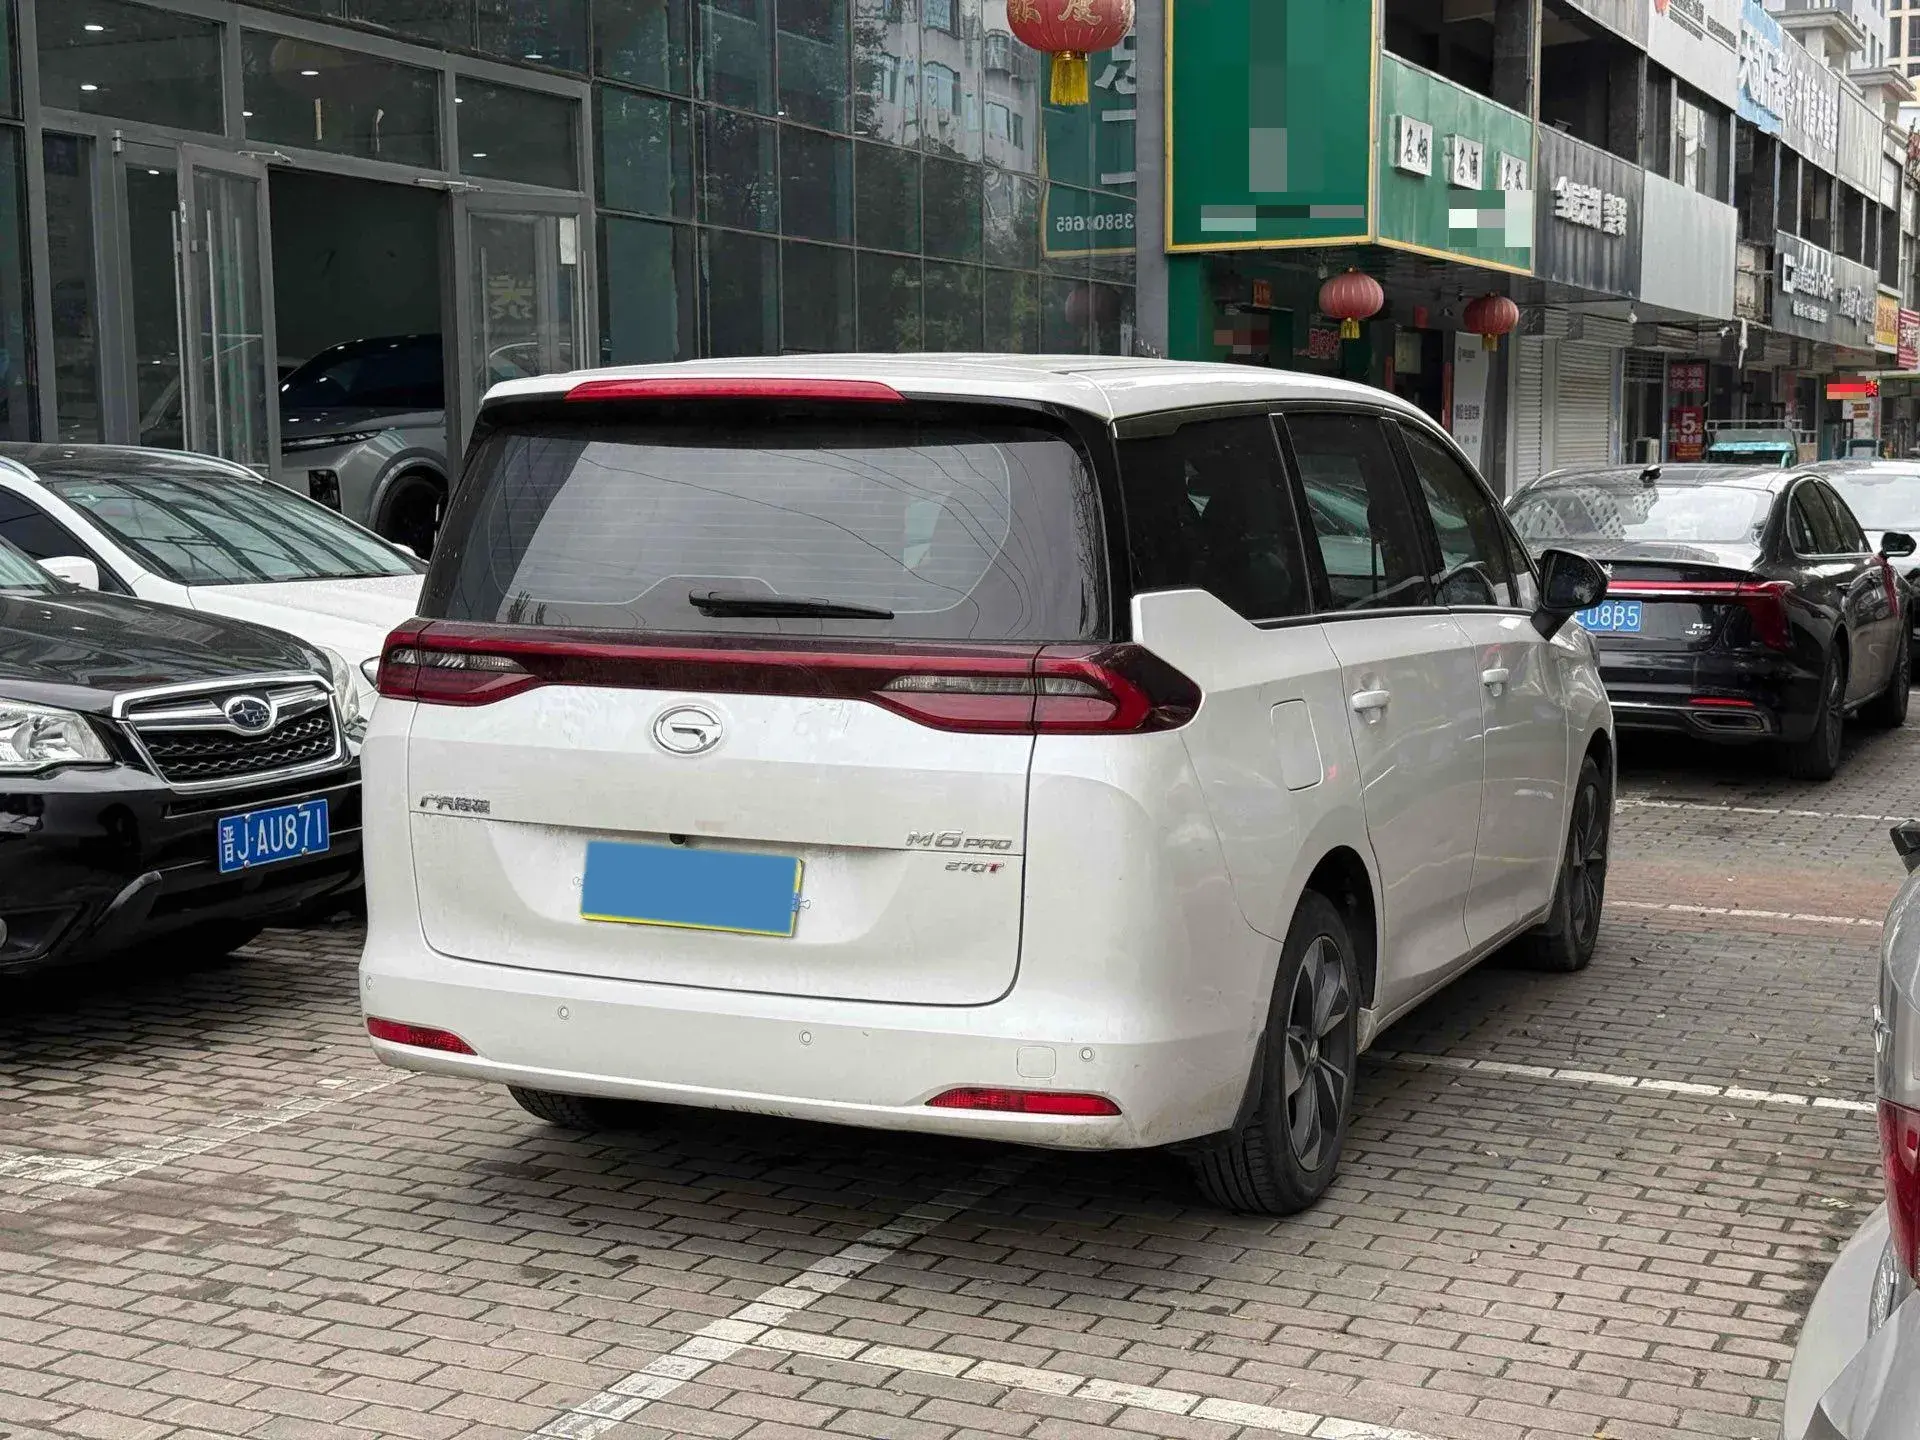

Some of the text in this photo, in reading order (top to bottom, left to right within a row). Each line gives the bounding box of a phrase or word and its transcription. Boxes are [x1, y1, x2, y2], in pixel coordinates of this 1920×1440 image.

[905, 829, 1012, 850] M6 PRO
[945, 860, 1005, 874] 270T
